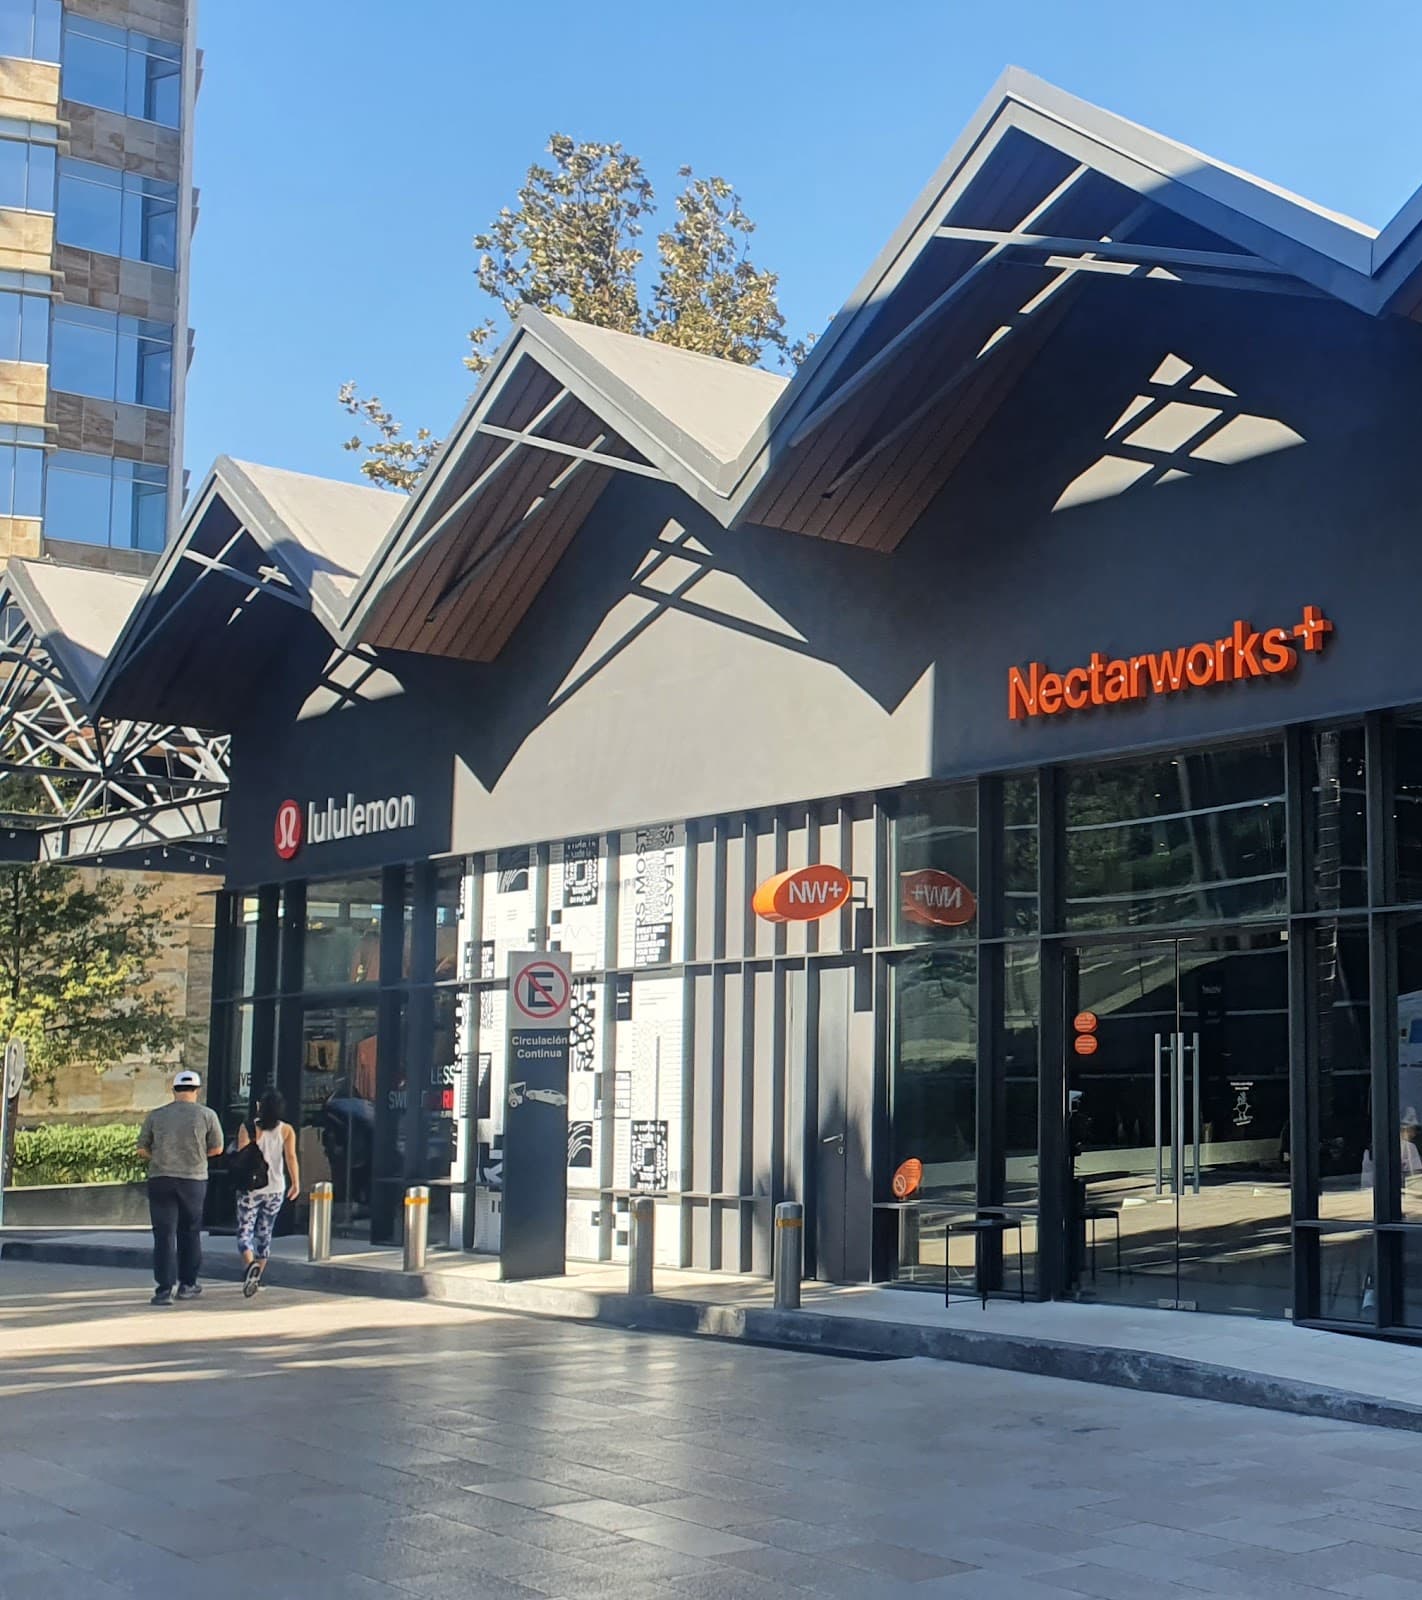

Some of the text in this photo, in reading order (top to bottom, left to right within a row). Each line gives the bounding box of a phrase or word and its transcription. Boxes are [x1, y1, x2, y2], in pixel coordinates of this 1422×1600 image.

[1008, 604, 1333, 720] Nectarworks+
[307, 792, 416, 845] lululemon
[788, 880, 843, 904] NW+
[511, 1034, 568, 1046] Circulación
[517, 1048, 562, 1059] Continua
